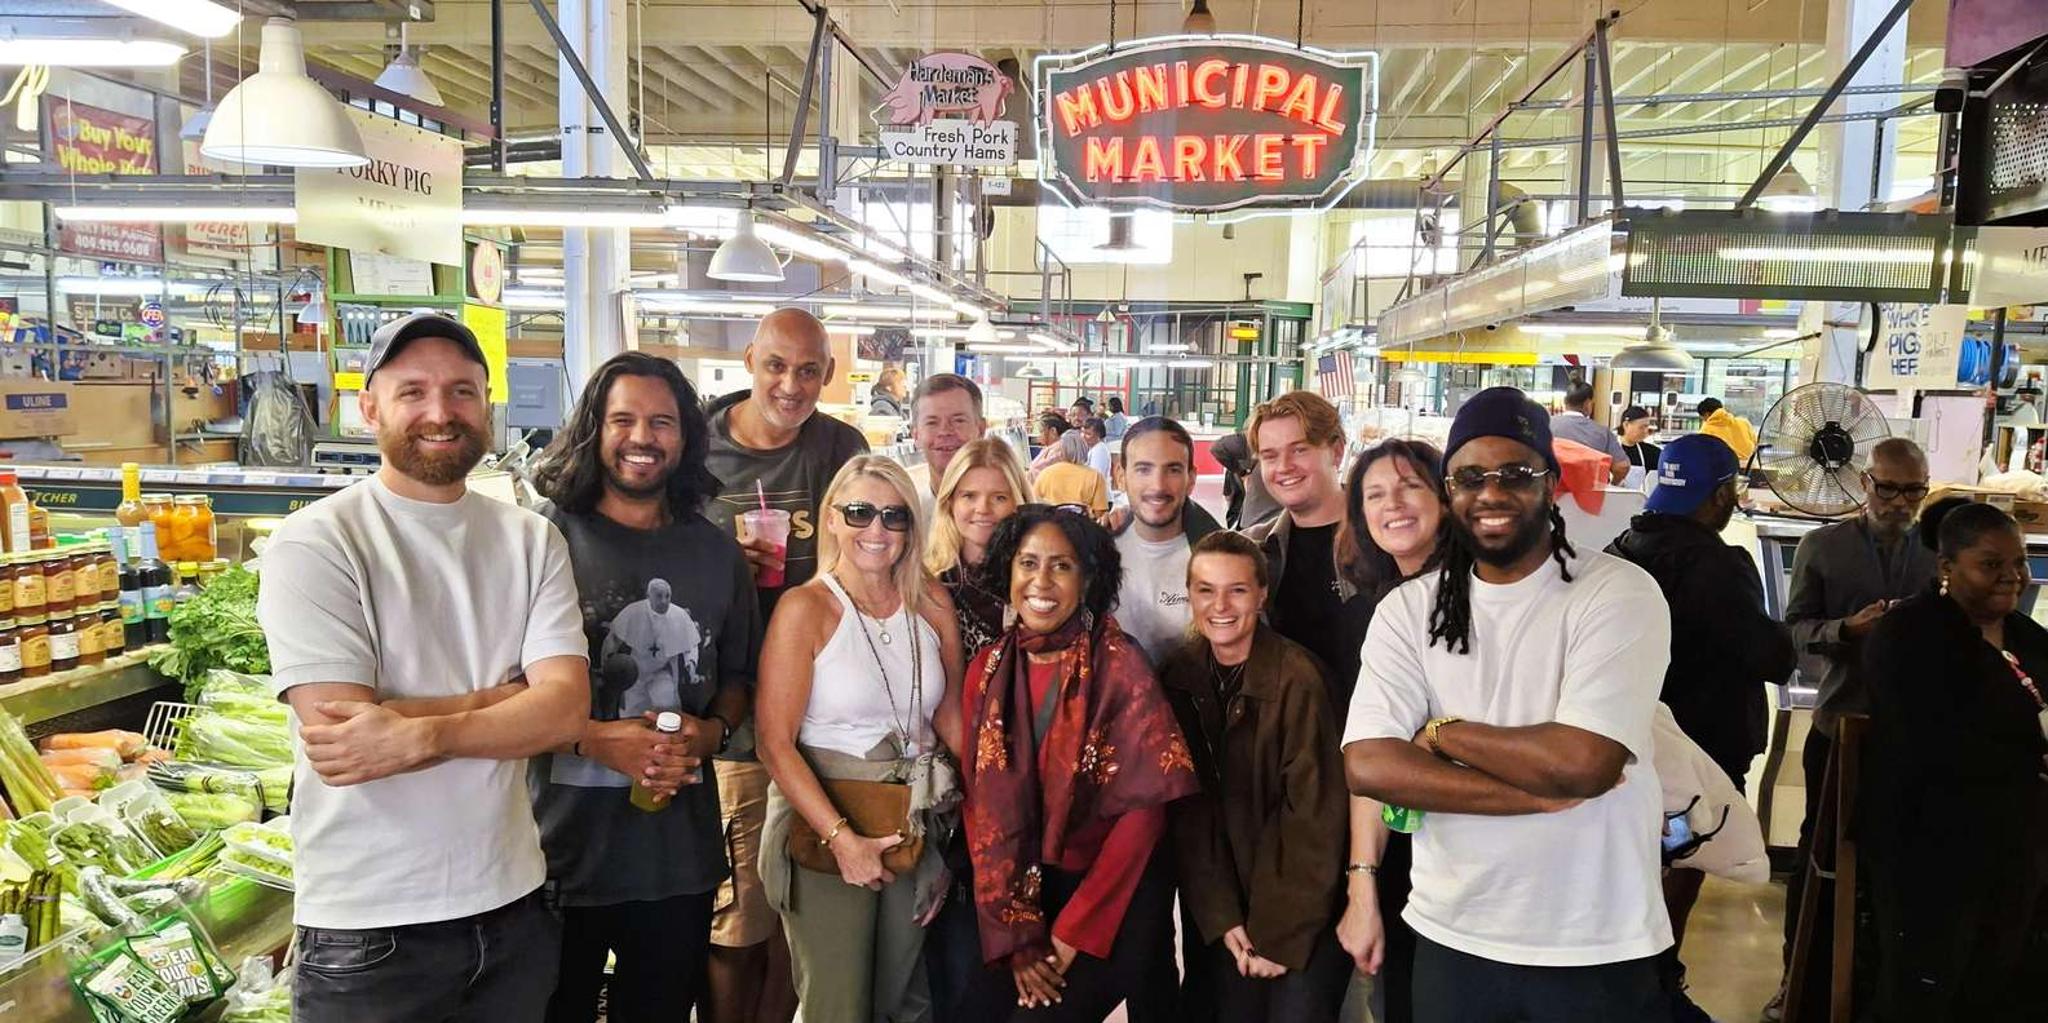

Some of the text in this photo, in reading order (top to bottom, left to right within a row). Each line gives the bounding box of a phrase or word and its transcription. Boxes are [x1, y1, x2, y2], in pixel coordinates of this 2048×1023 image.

[910, 61, 996, 84] Hardeman's
[920, 85, 980, 105] Market
[1056, 60, 1346, 137] MUNICIPAL
[79, 118, 152, 154] Buy Your
[925, 127, 1009, 145] Fresh Pork
[57, 143, 116, 175] Whole
[894, 141, 1006, 162] Country Hams
[1086, 133, 1329, 183] MARKET
[404, 166, 432, 196] PIG
[22, 395, 53, 408] ULINE
[168, 946, 197, 964] EAT
[126, 969, 151, 991] EAT
[124, 986, 160, 1015] YOUR
